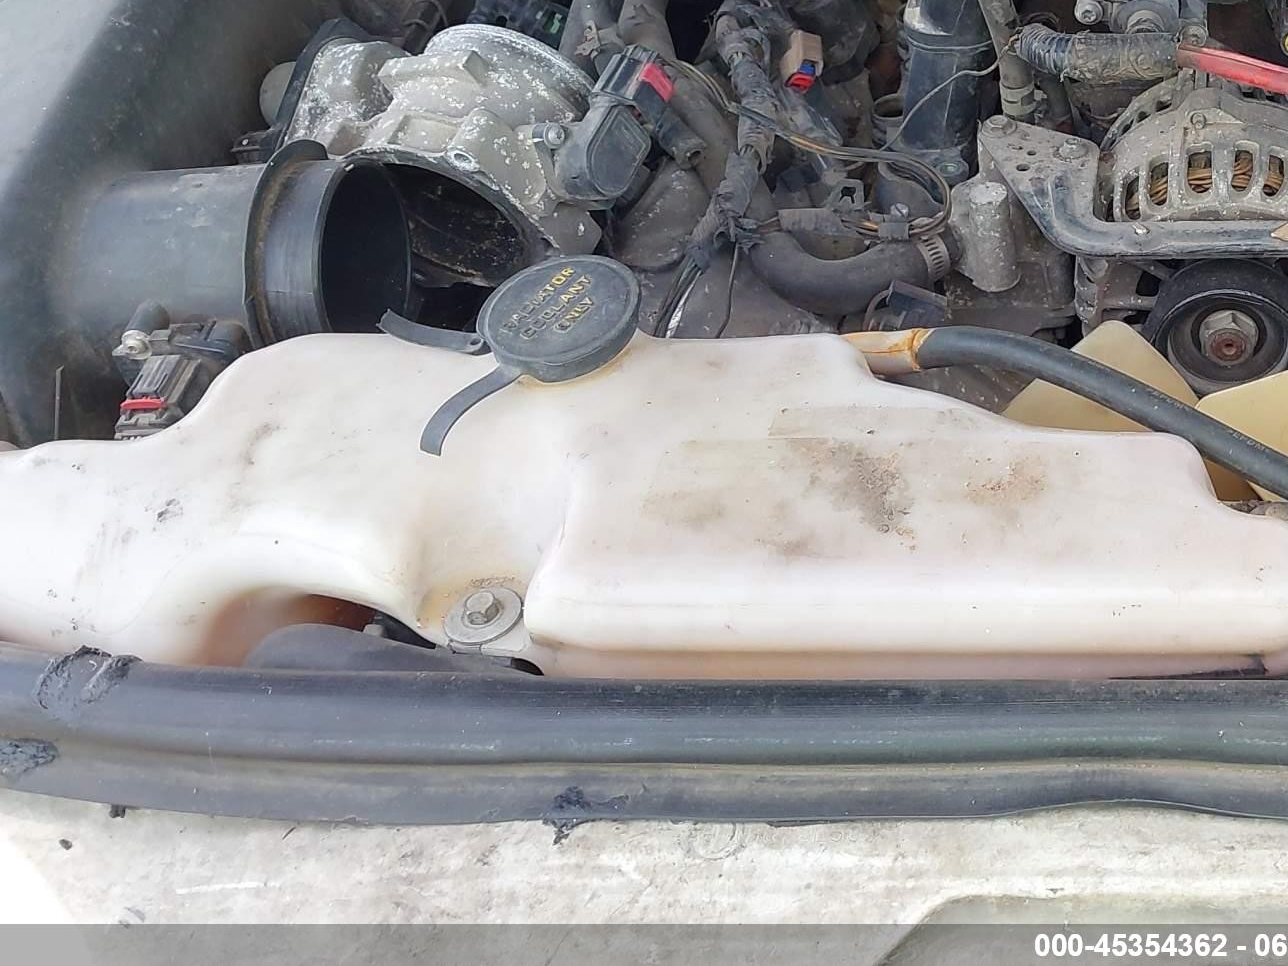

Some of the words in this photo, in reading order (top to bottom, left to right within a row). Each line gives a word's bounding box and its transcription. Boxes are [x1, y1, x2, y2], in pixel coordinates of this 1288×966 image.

[501, 266, 575, 334] RADIATOR
[520, 274, 592, 339] COOLANT
[553, 296, 594, 333] ONLY
